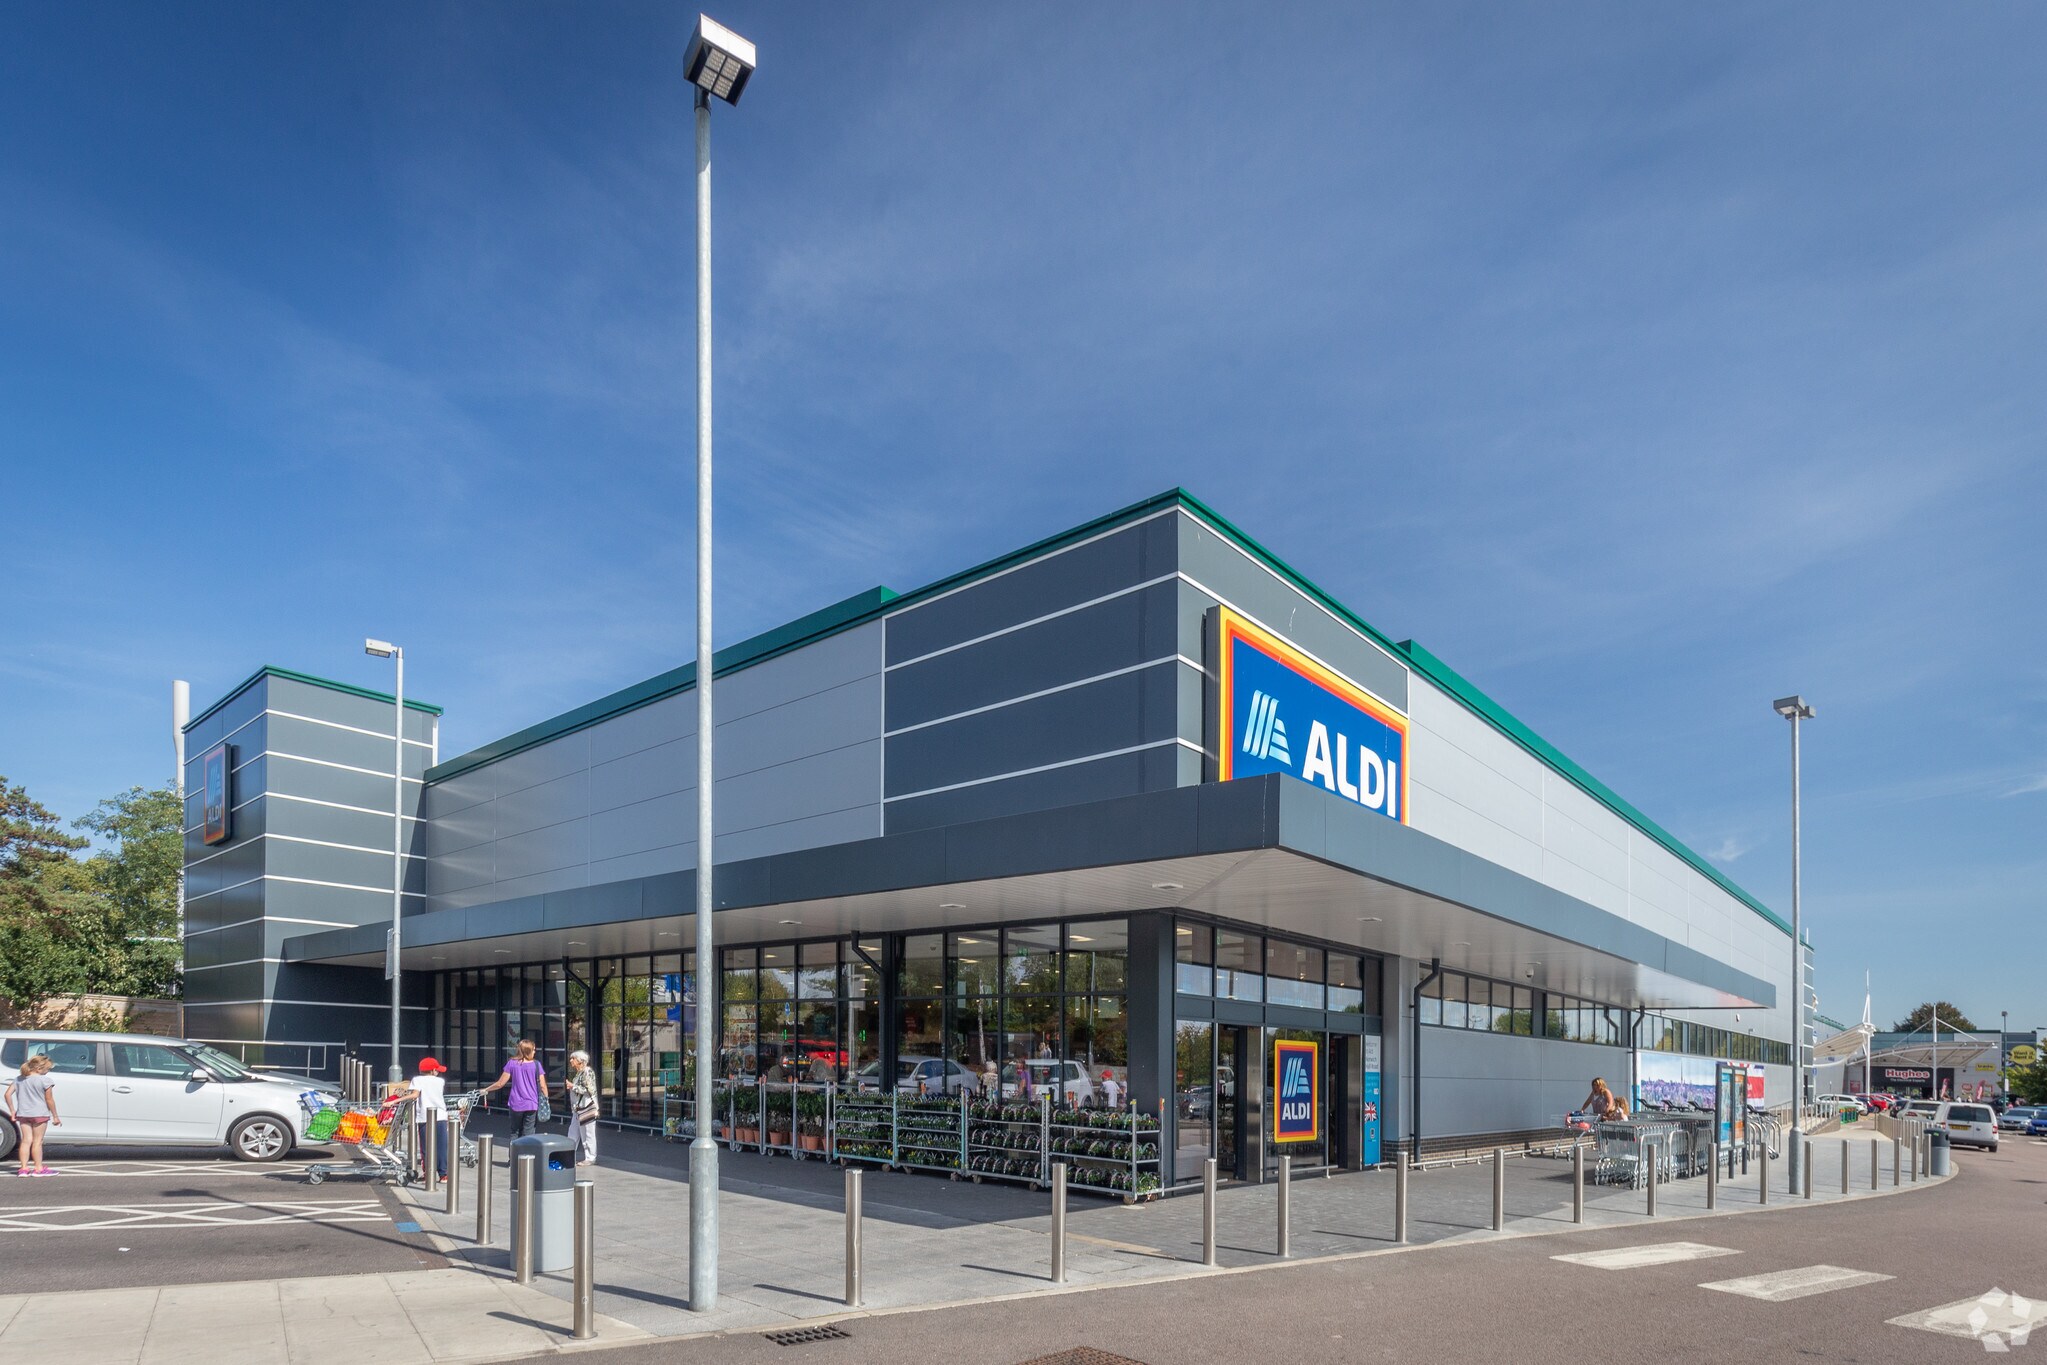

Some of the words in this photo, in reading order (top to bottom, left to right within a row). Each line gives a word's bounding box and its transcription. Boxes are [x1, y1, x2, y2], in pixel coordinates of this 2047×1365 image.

[1302, 719, 1396, 819] ALDI
[207, 803, 222, 825] ALDI
[1885, 1069, 1930, 1079] Hughes
[1282, 1102, 1311, 1120] ALDI
